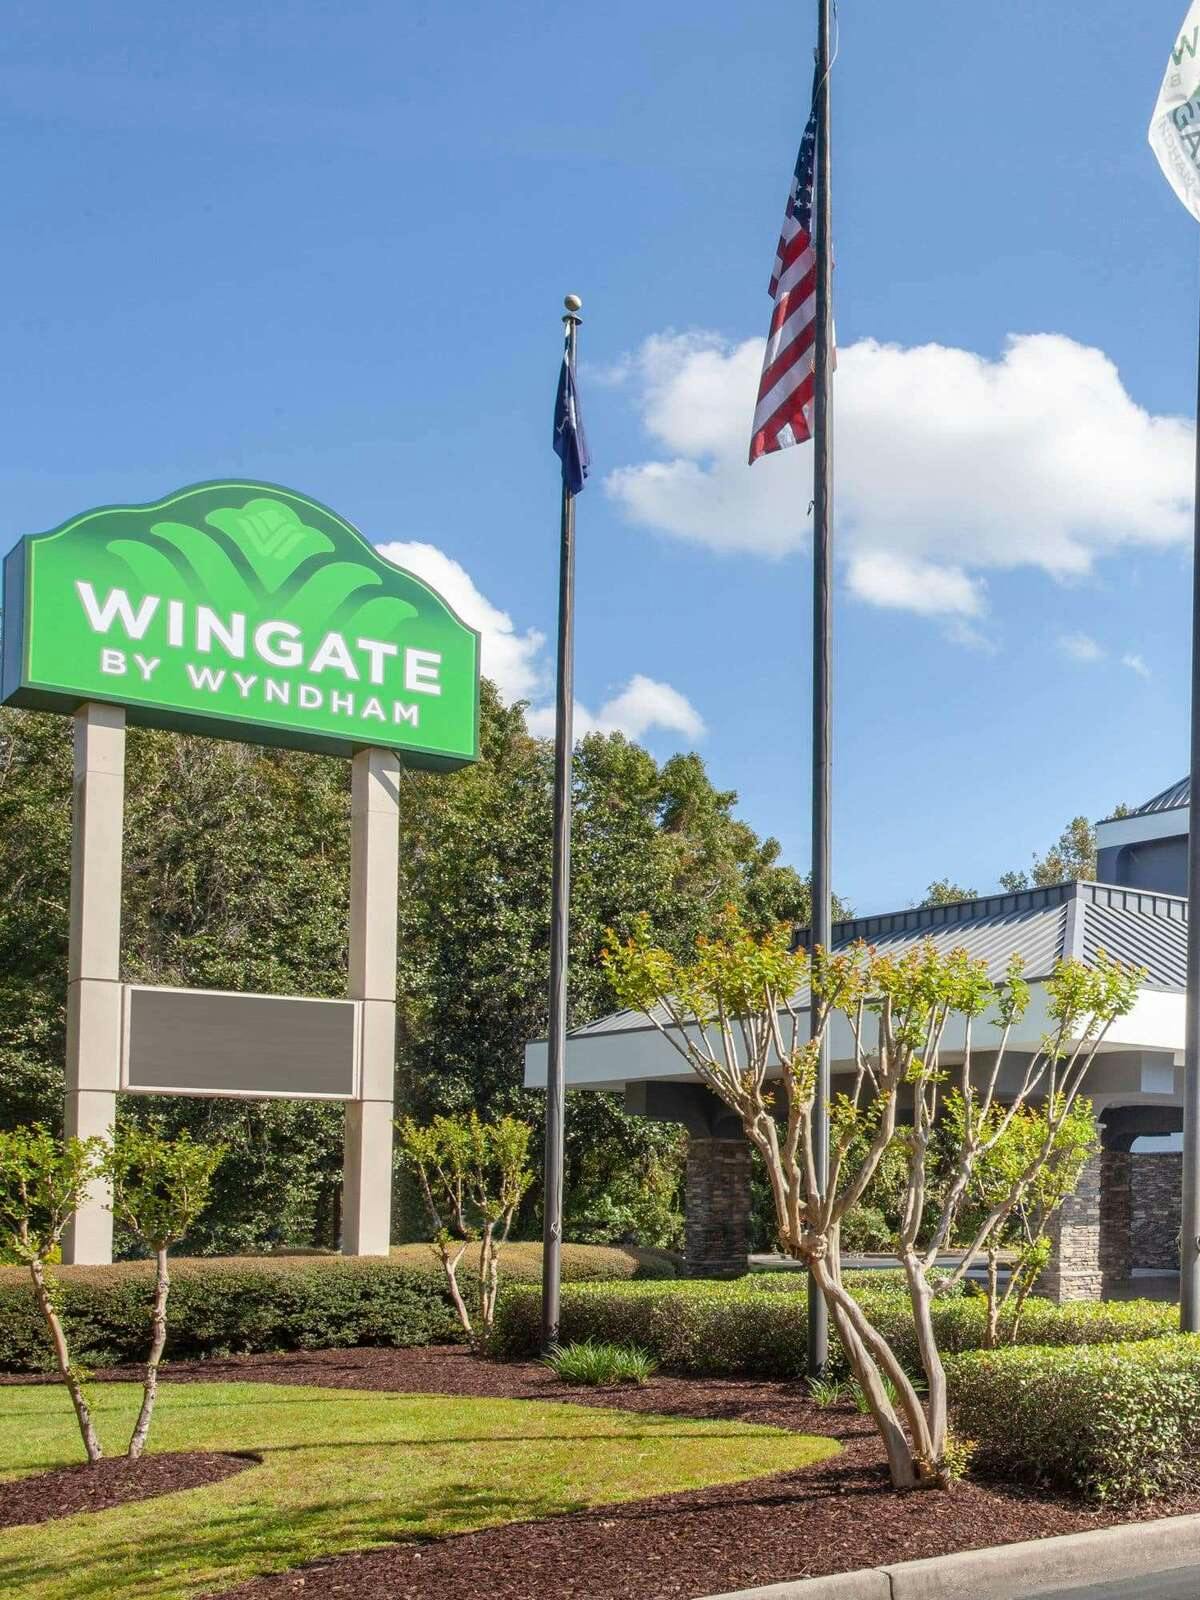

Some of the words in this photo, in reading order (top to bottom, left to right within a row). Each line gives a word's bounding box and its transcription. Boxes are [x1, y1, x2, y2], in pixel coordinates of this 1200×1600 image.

[75, 580, 442, 695] WINGATE
[101, 648, 161, 680] BY
[187, 664, 419, 727] WYNDHAM
